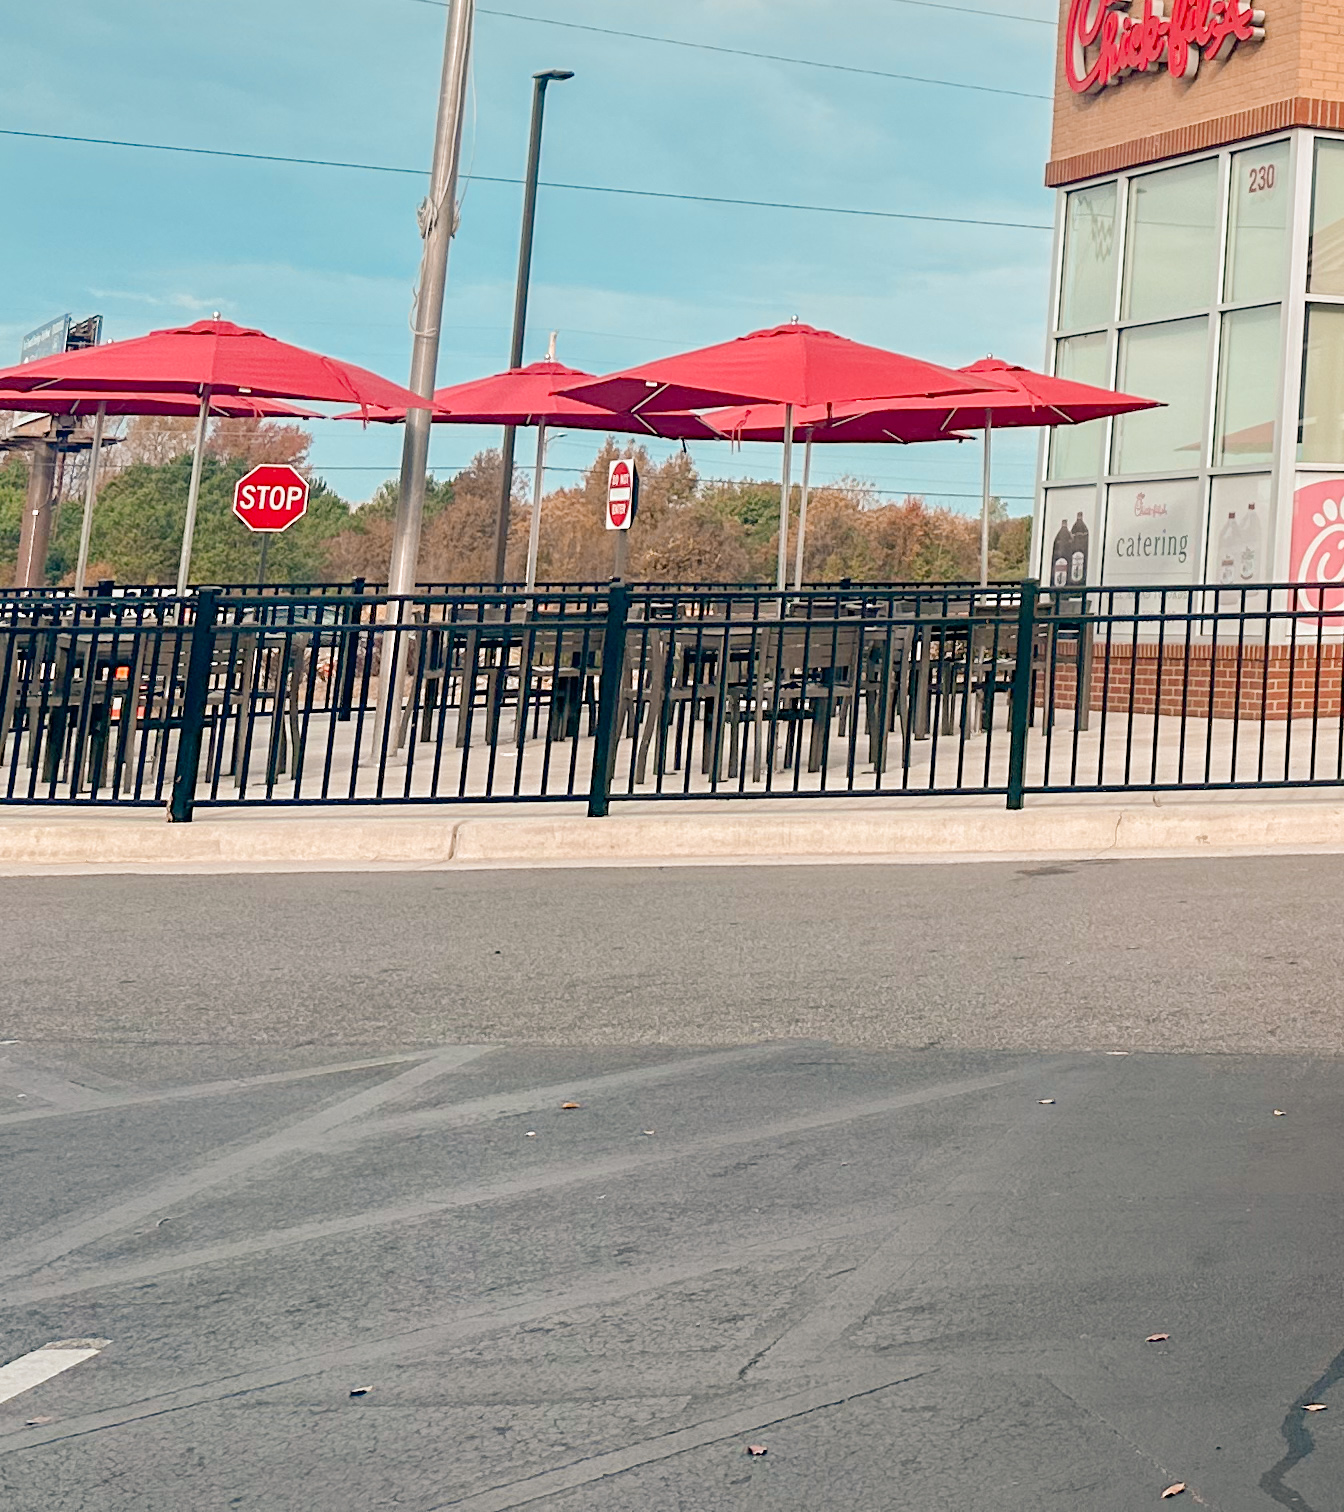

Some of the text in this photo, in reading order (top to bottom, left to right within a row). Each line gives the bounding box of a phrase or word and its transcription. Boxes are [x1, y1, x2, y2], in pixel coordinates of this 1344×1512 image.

[1248, 163, 1275, 194] 230
[239, 484, 303, 511] STOP
[1116, 528, 1189, 564] catering
